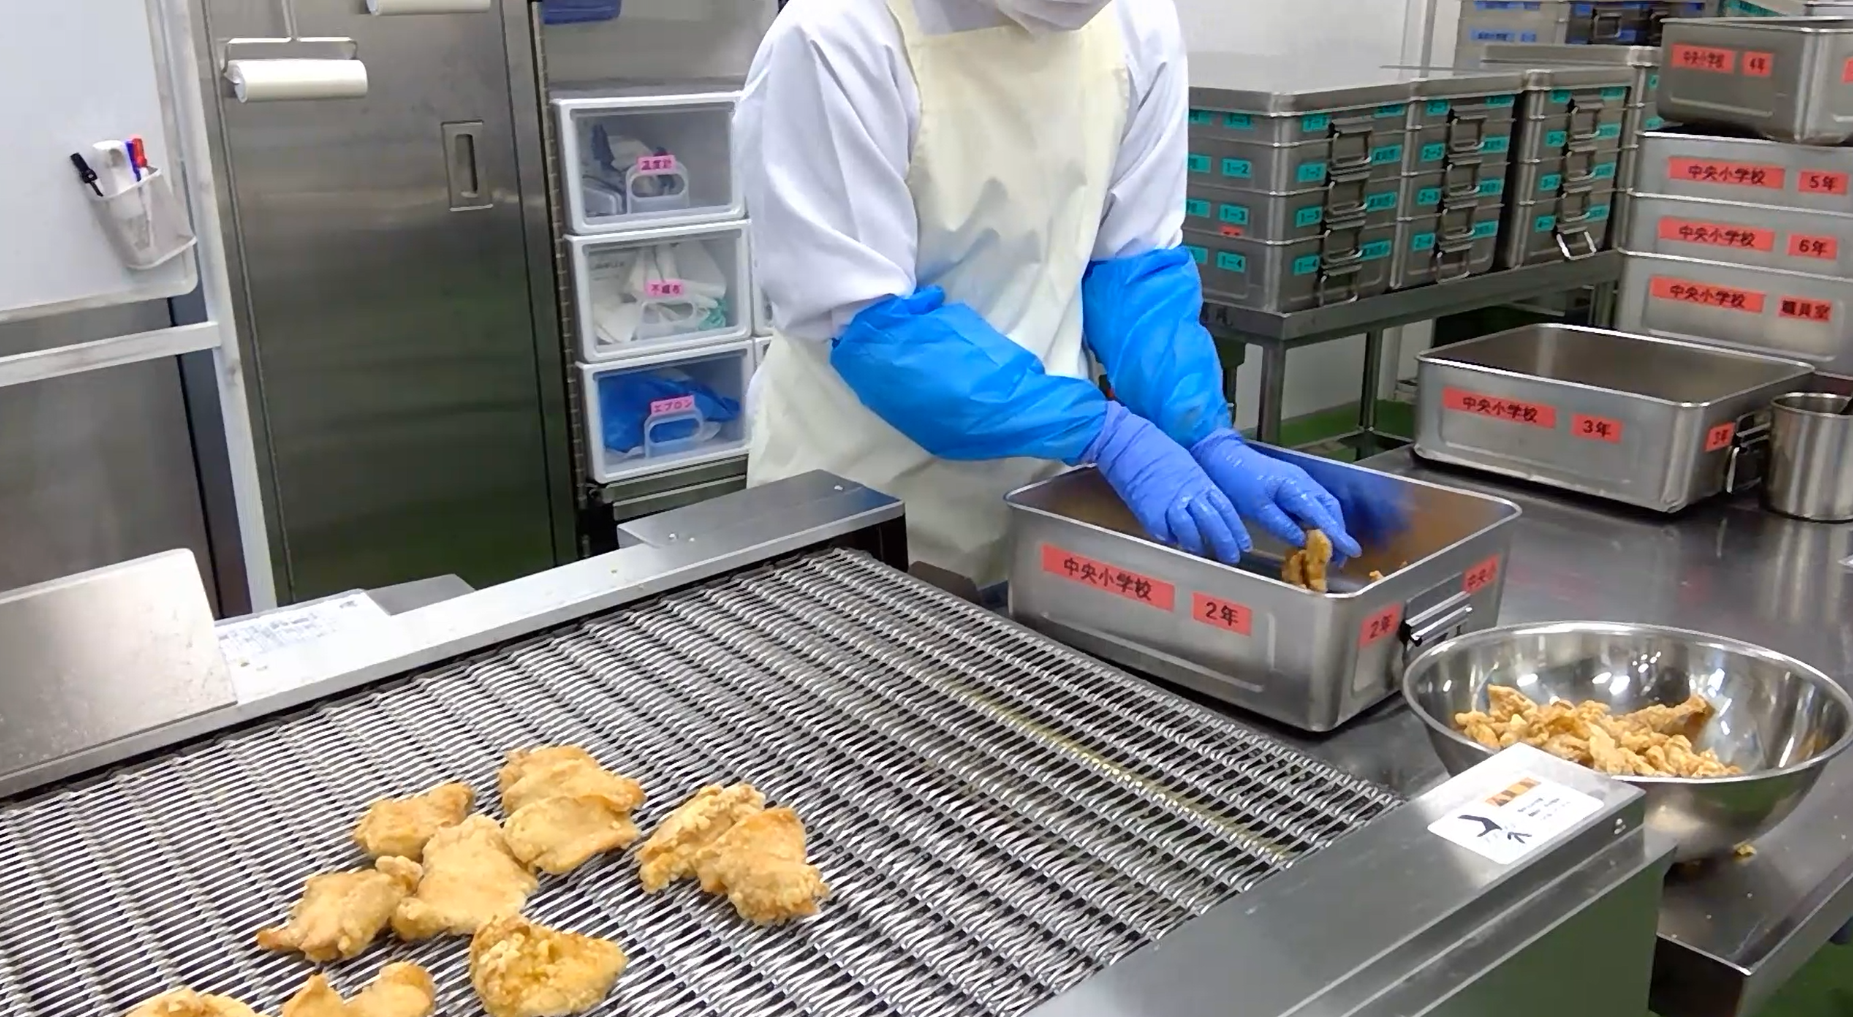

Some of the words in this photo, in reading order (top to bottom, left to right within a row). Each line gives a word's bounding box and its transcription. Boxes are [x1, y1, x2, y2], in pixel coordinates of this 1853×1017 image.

[1226, 162, 1249, 175] 1-2
[1688, 164, 1766, 185] 中央小学校
[1808, 174, 1838, 191] 5年
[1223, 208, 1246, 220] 1-3
[1300, 209, 1320, 221] 1-3
[1678, 225, 1757, 248] 中央小学校
[1798, 239, 1828, 256] 6年
[1221, 255, 1243, 268] 1-4
[1670, 284, 1747, 309] 中央小学校
[1462, 396, 1538, 424] 中央小学校
[1582, 419, 1612, 438] 3年
[1063, 557, 1152, 601] 中央小学校
[1205, 602, 1239, 626] 2年
